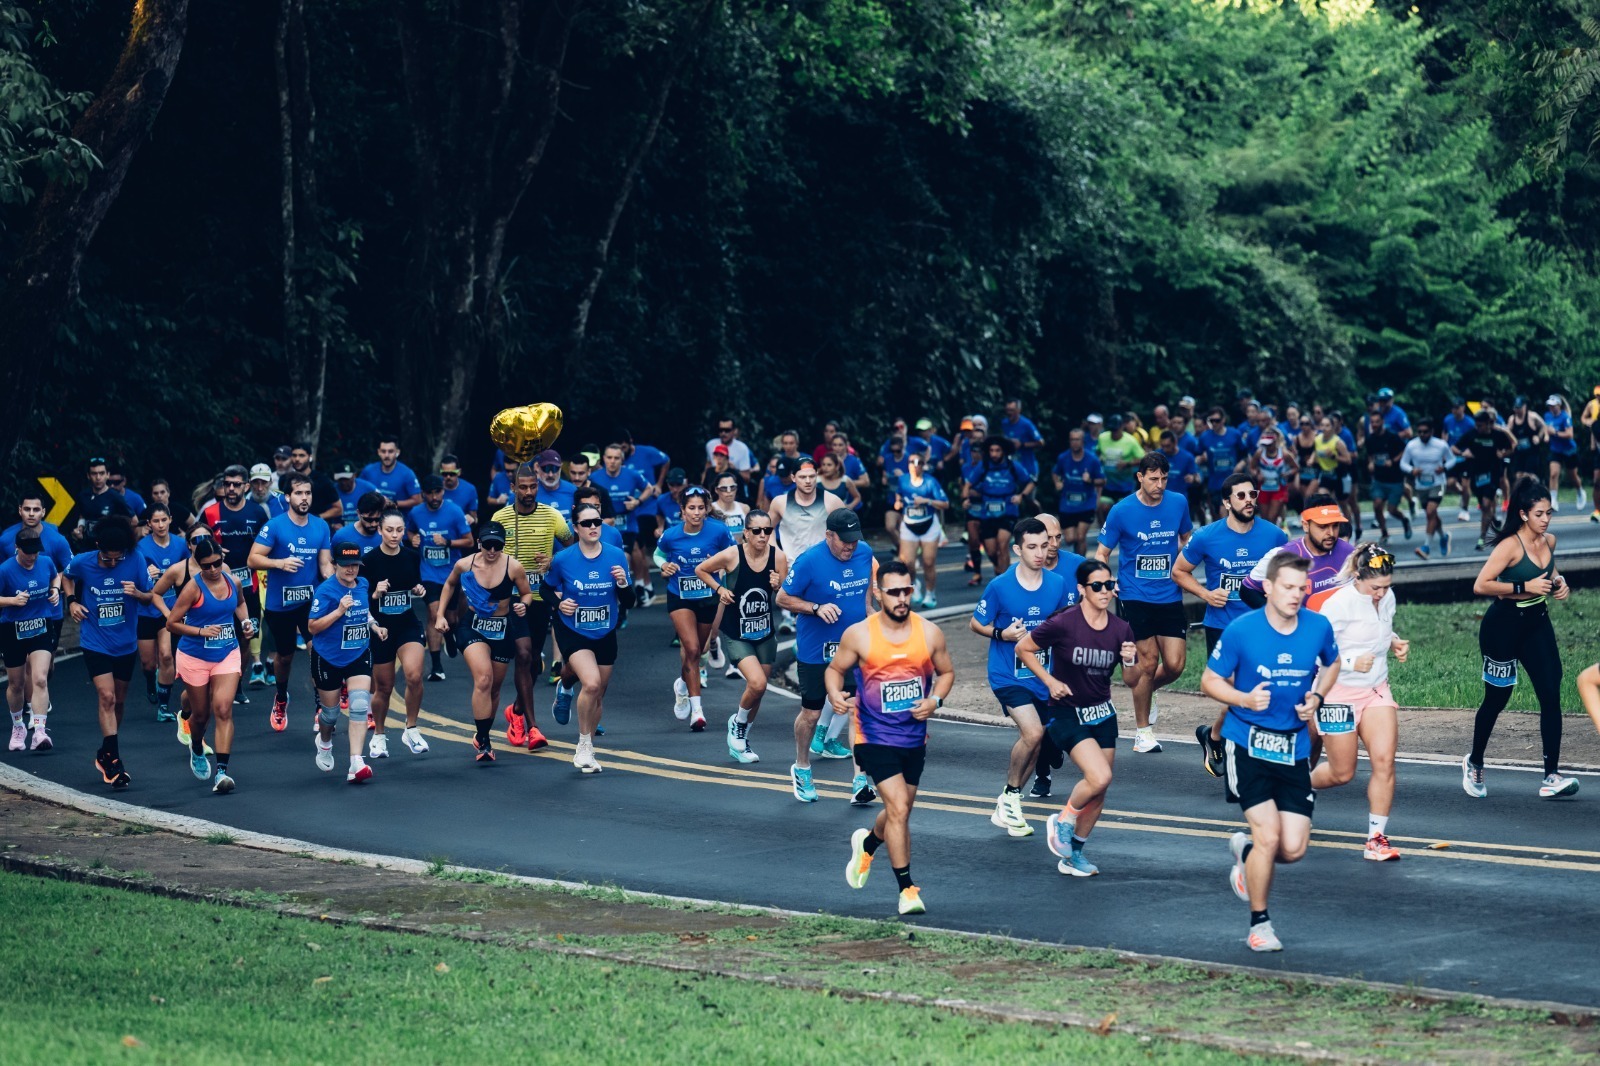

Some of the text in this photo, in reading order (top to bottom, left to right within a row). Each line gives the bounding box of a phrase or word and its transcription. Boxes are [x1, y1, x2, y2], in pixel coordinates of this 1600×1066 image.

[427, 550, 445, 559] 21316
[1141, 558, 1166, 571] 22139
[683, 579, 707, 591] 21494
[287, 590, 310, 601] 21554
[384, 594, 407, 607] 21769
[99, 606, 123, 618] 21567
[580, 610, 606, 623] 21048
[18, 618, 44, 632] 22283
[477, 619, 502, 632] 21239
[208, 627, 233, 640] 092
[347, 627, 367, 641] 21272
[1072, 646, 1114, 668] GUMP
[1487, 663, 1511, 678] 21737
[886, 683, 919, 702] 22066
[1082, 701, 1111, 723] 22159
[1320, 708, 1348, 722] 21307
[1254, 732, 1289, 753] 21324
